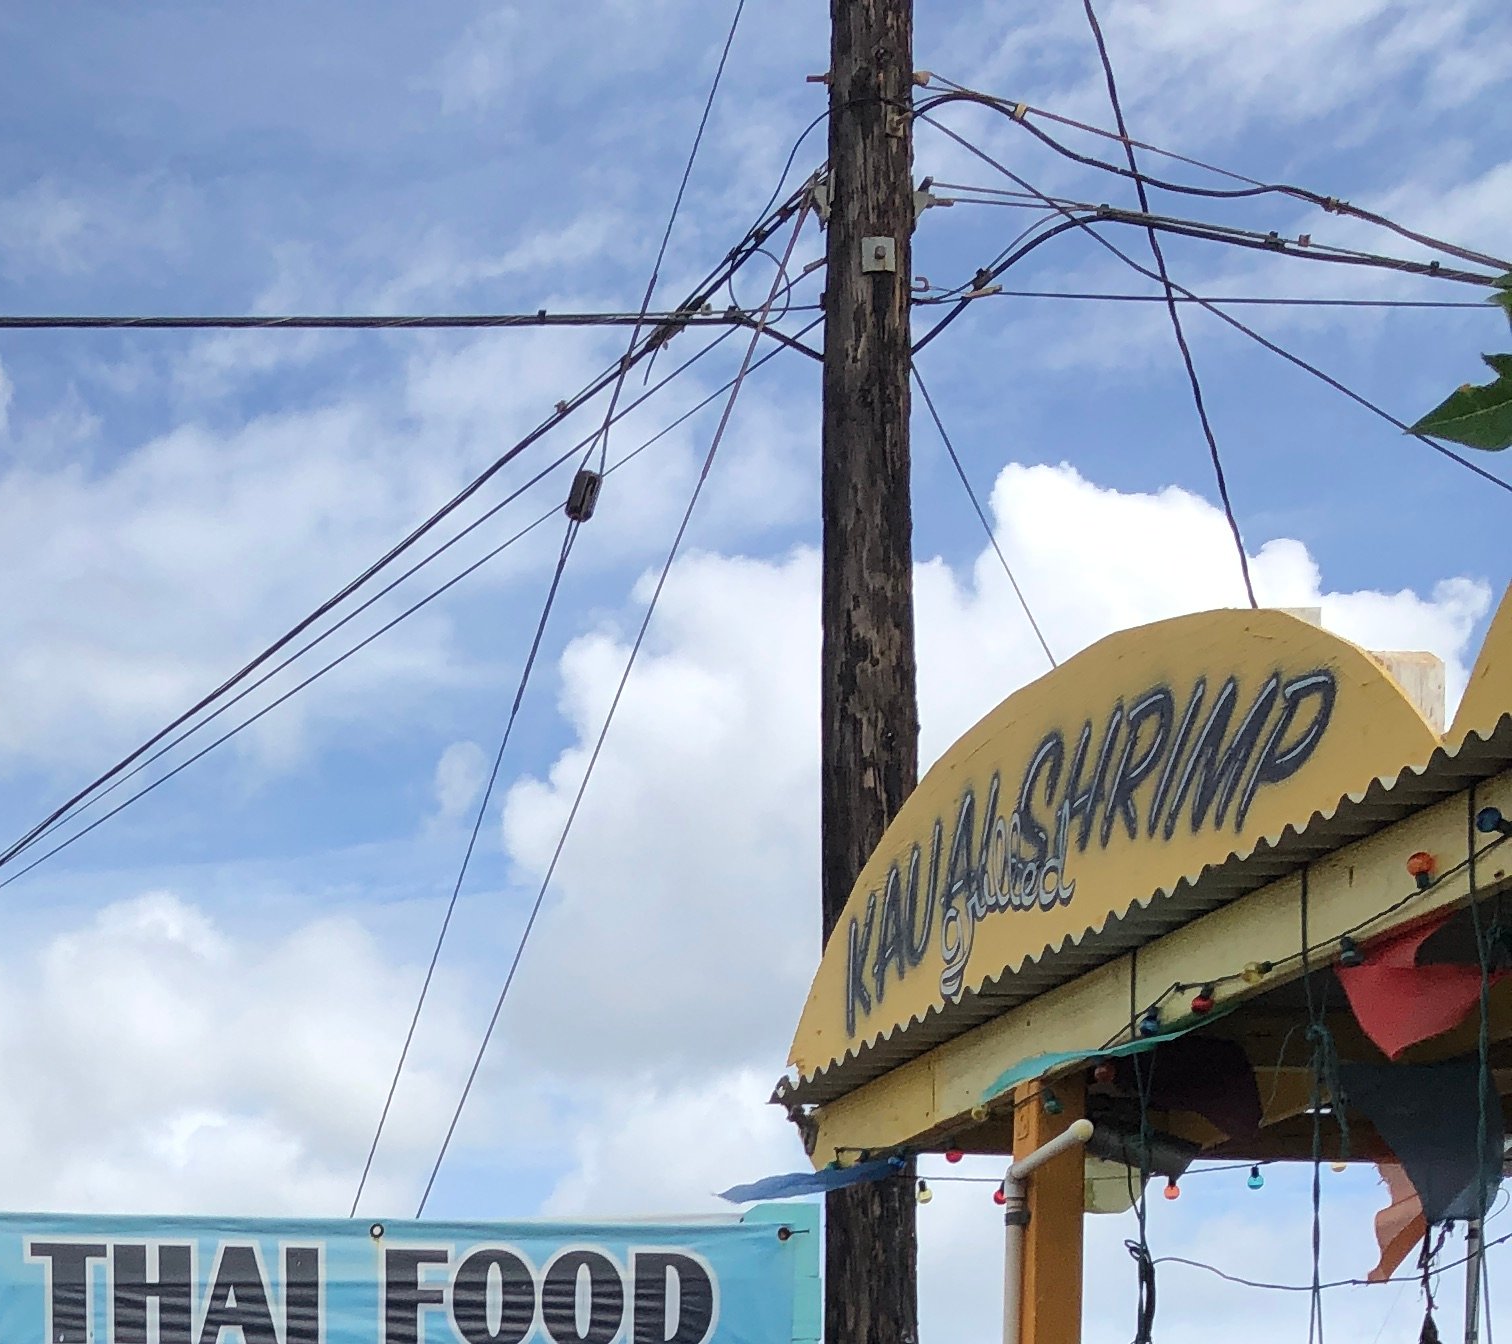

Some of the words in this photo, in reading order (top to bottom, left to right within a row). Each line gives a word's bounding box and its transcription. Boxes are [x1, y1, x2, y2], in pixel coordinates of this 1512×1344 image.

[845, 768, 1002, 1038] KAUAI
[1010, 668, 1337, 866] SHRIMP
[939, 798, 1076, 1000] grilled
